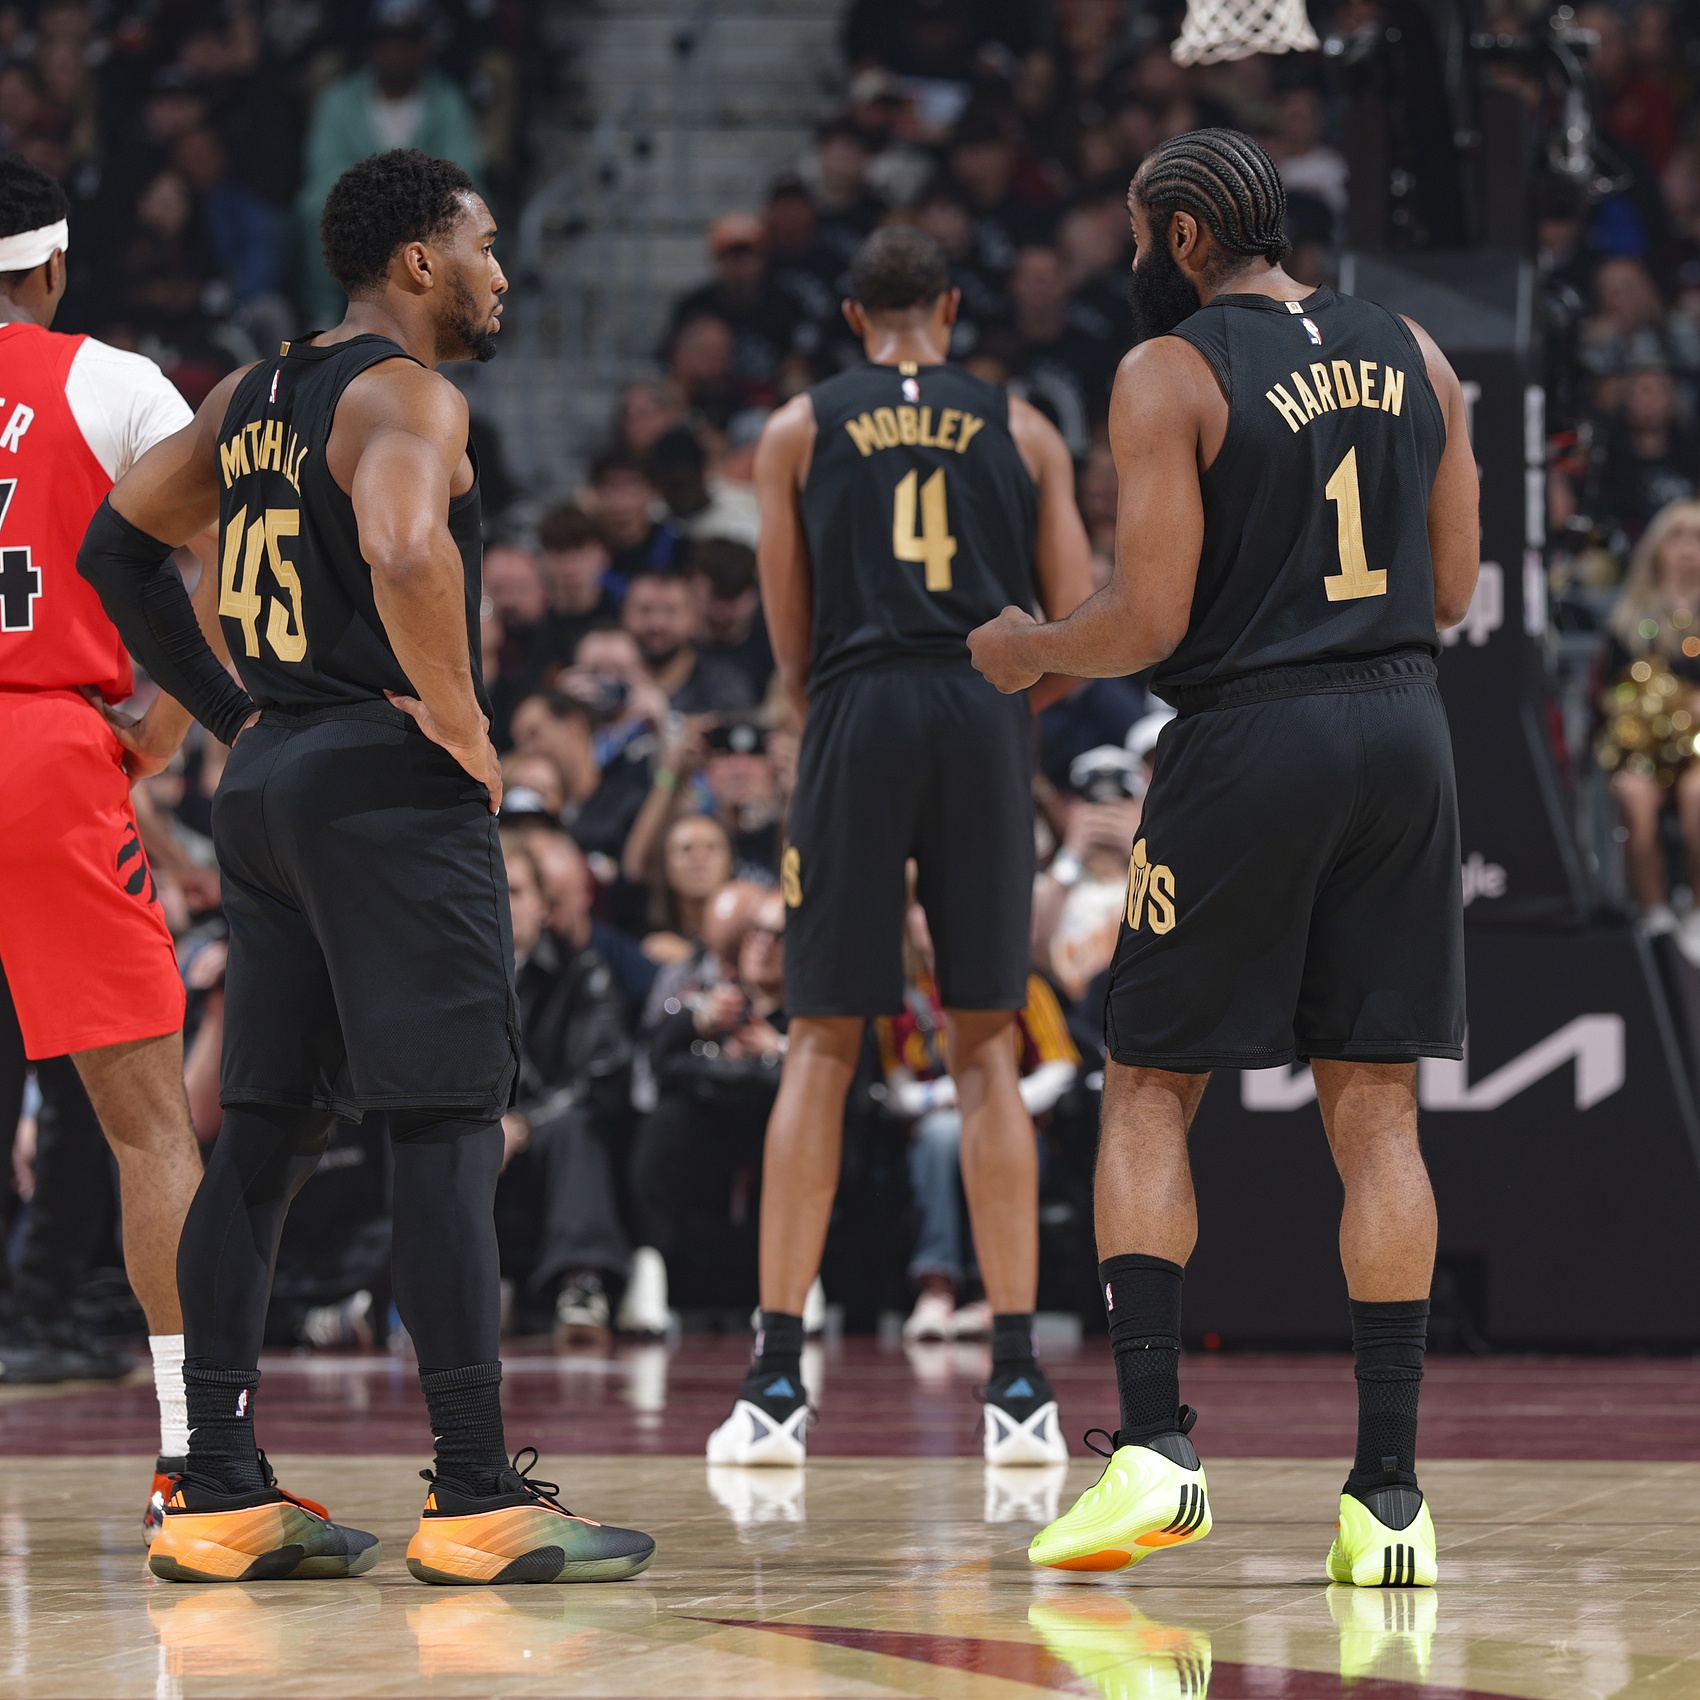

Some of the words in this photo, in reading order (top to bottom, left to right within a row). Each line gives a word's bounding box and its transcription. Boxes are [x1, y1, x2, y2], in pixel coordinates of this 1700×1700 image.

[845, 405, 985, 457] MOBLEY
[1265, 359, 1405, 433] HARDEN
[218, 503, 308, 663] 45
[893, 466, 957, 592] 4
[1324, 445, 1388, 602] 1
